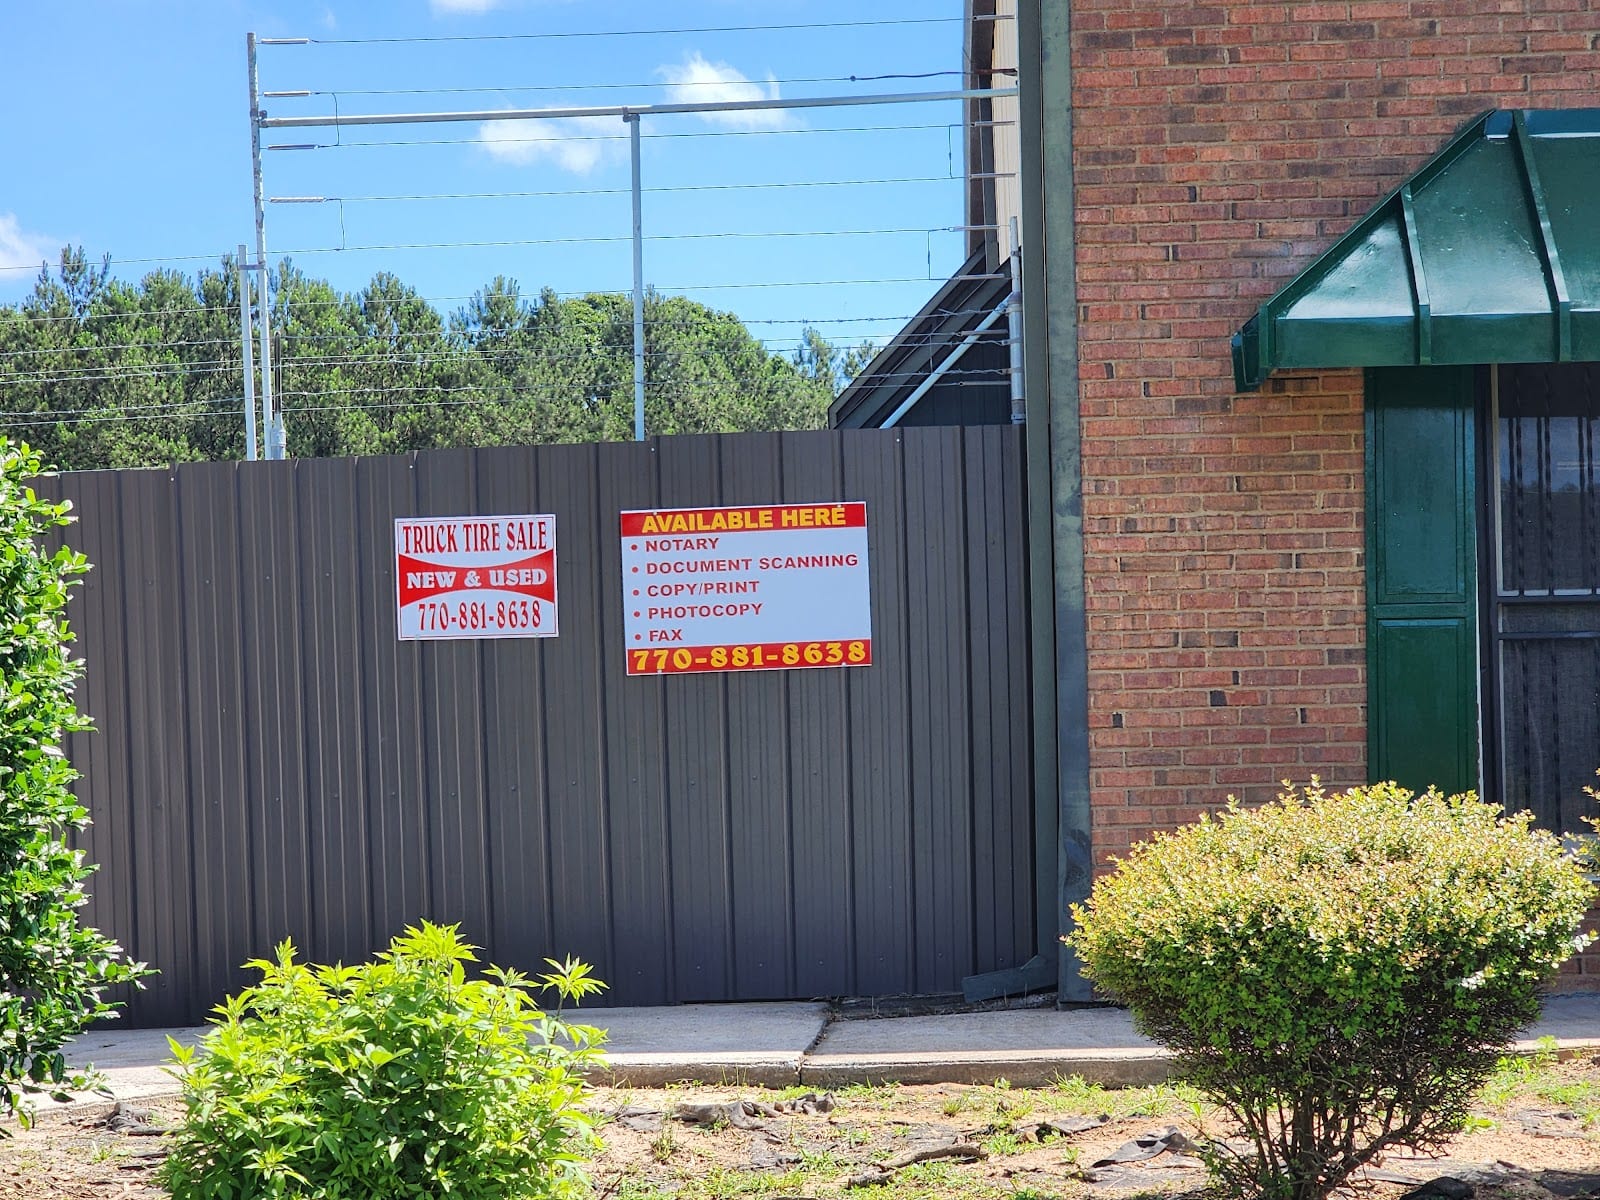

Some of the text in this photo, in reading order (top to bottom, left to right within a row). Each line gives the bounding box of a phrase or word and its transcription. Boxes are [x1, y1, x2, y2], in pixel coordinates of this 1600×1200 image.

[642, 507, 846, 533] AVAILABLE HERE
[403, 521, 547, 554] TRUCK TIRE SALE
[645, 537, 719, 553] NOTARY
[646, 554, 858, 575] DOCUMENT SCANNING
[407, 568, 547, 589] NEW & USED
[647, 580, 760, 597] COPY/PRINT
[418, 600, 541, 631] 770-881-8638
[648, 603, 763, 620] PHOTOCOPY
[649, 628, 683, 642] FAX
[633, 641, 866, 671] 770-881-8638
